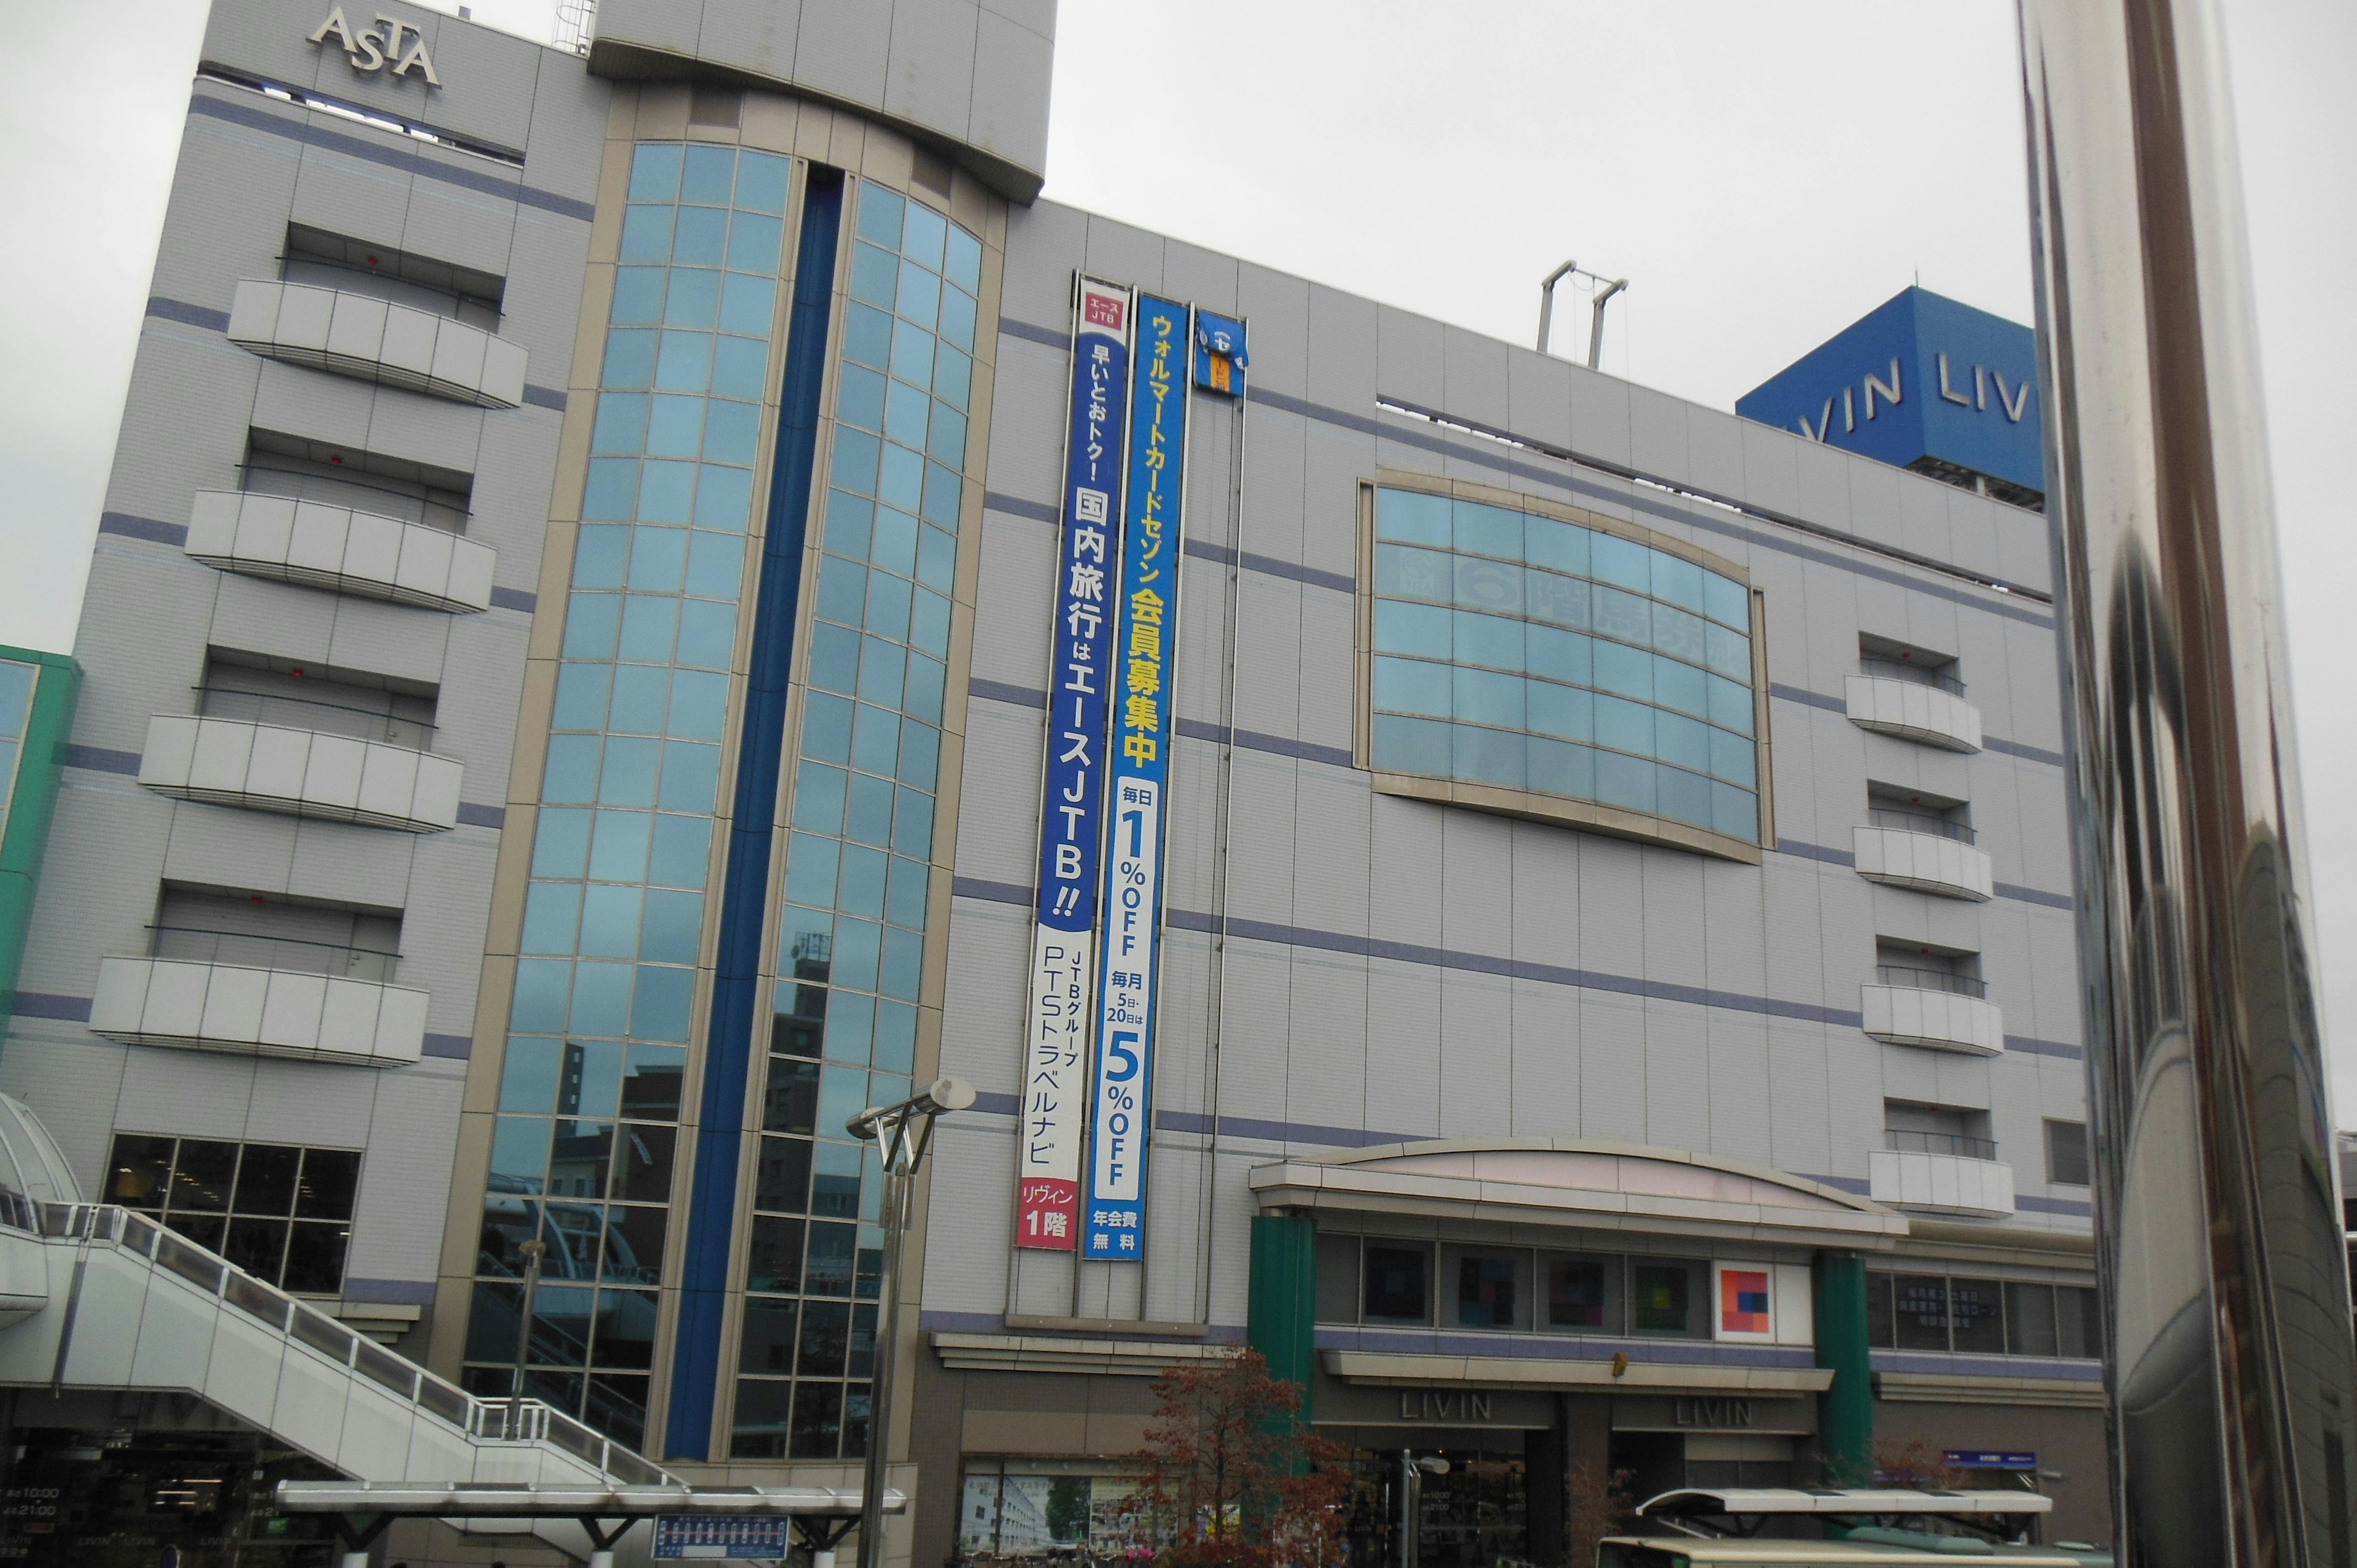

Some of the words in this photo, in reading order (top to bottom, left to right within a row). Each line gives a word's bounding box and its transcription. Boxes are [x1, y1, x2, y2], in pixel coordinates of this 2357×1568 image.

[306, 6, 442, 90] ASTA
[1090, 297, 1118, 314] エース
[1091, 311, 1114, 324] JTB
[1782, 357, 1902, 443] VIN
[1936, 352, 2029, 423] LIV
[1123, 786, 1152, 806] 毎日
[1112, 970, 1142, 990] 毎月
[1064, 951, 1082, 1067] JTBグループ
[1107, 1008, 1143, 1024] 20日は
[1031, 946, 1064, 1164] PTSトラベルナビ
[1023, 1185, 1072, 1205] リヴィン
[1026, 1210, 1067, 1237] 1階
[1093, 1211, 1137, 1228] 年会費
[1402, 1392, 1491, 1420] LIVIN
[1677, 1400, 1751, 1425] LIVIN
